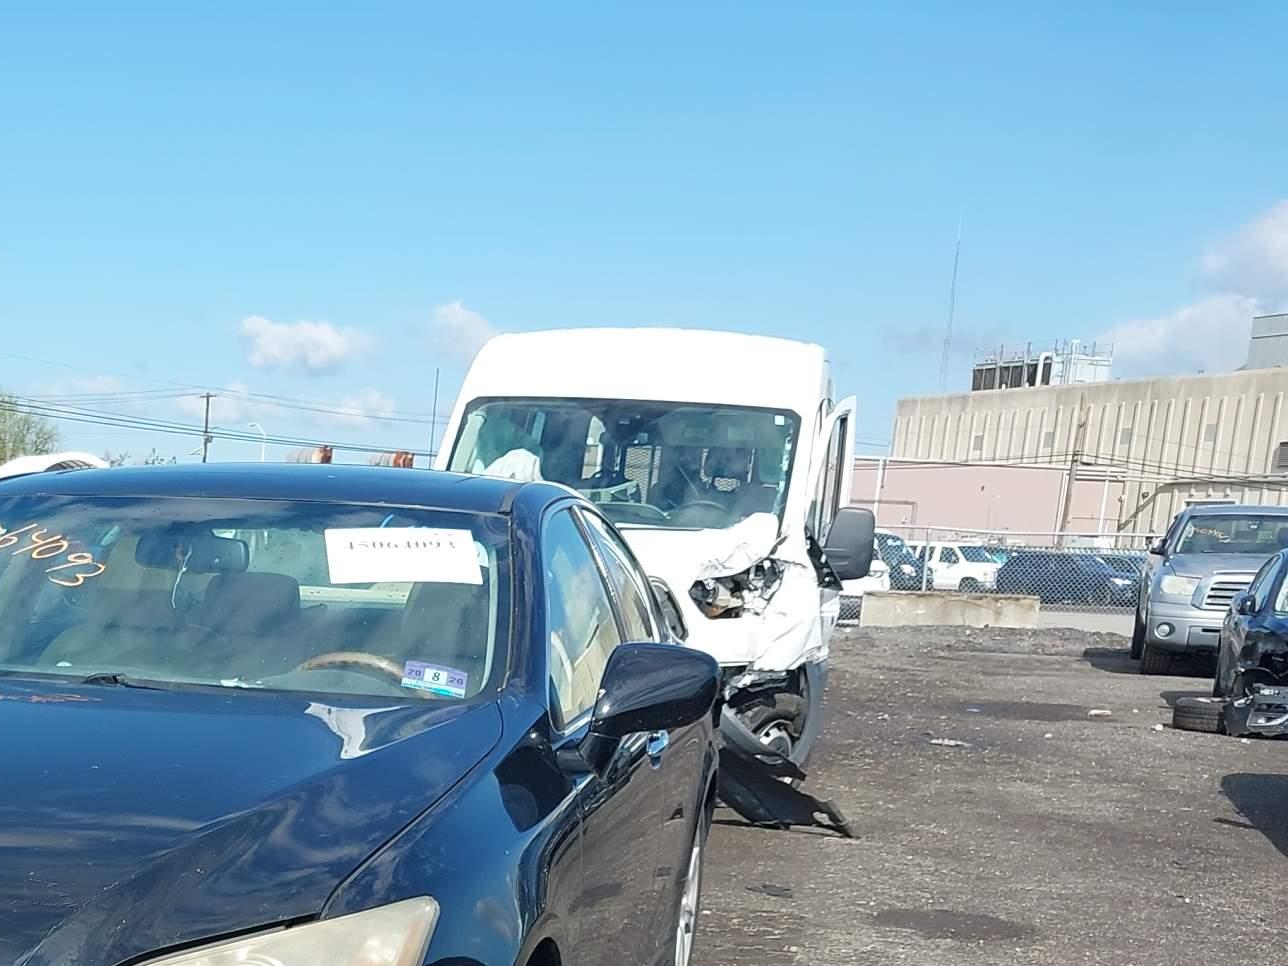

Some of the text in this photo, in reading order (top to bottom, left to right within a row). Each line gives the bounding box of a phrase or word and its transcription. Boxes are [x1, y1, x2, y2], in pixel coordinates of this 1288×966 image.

[406, 668, 422, 677] 20
[431, 671, 441, 682] 8
[447, 676, 464, 686] 26
